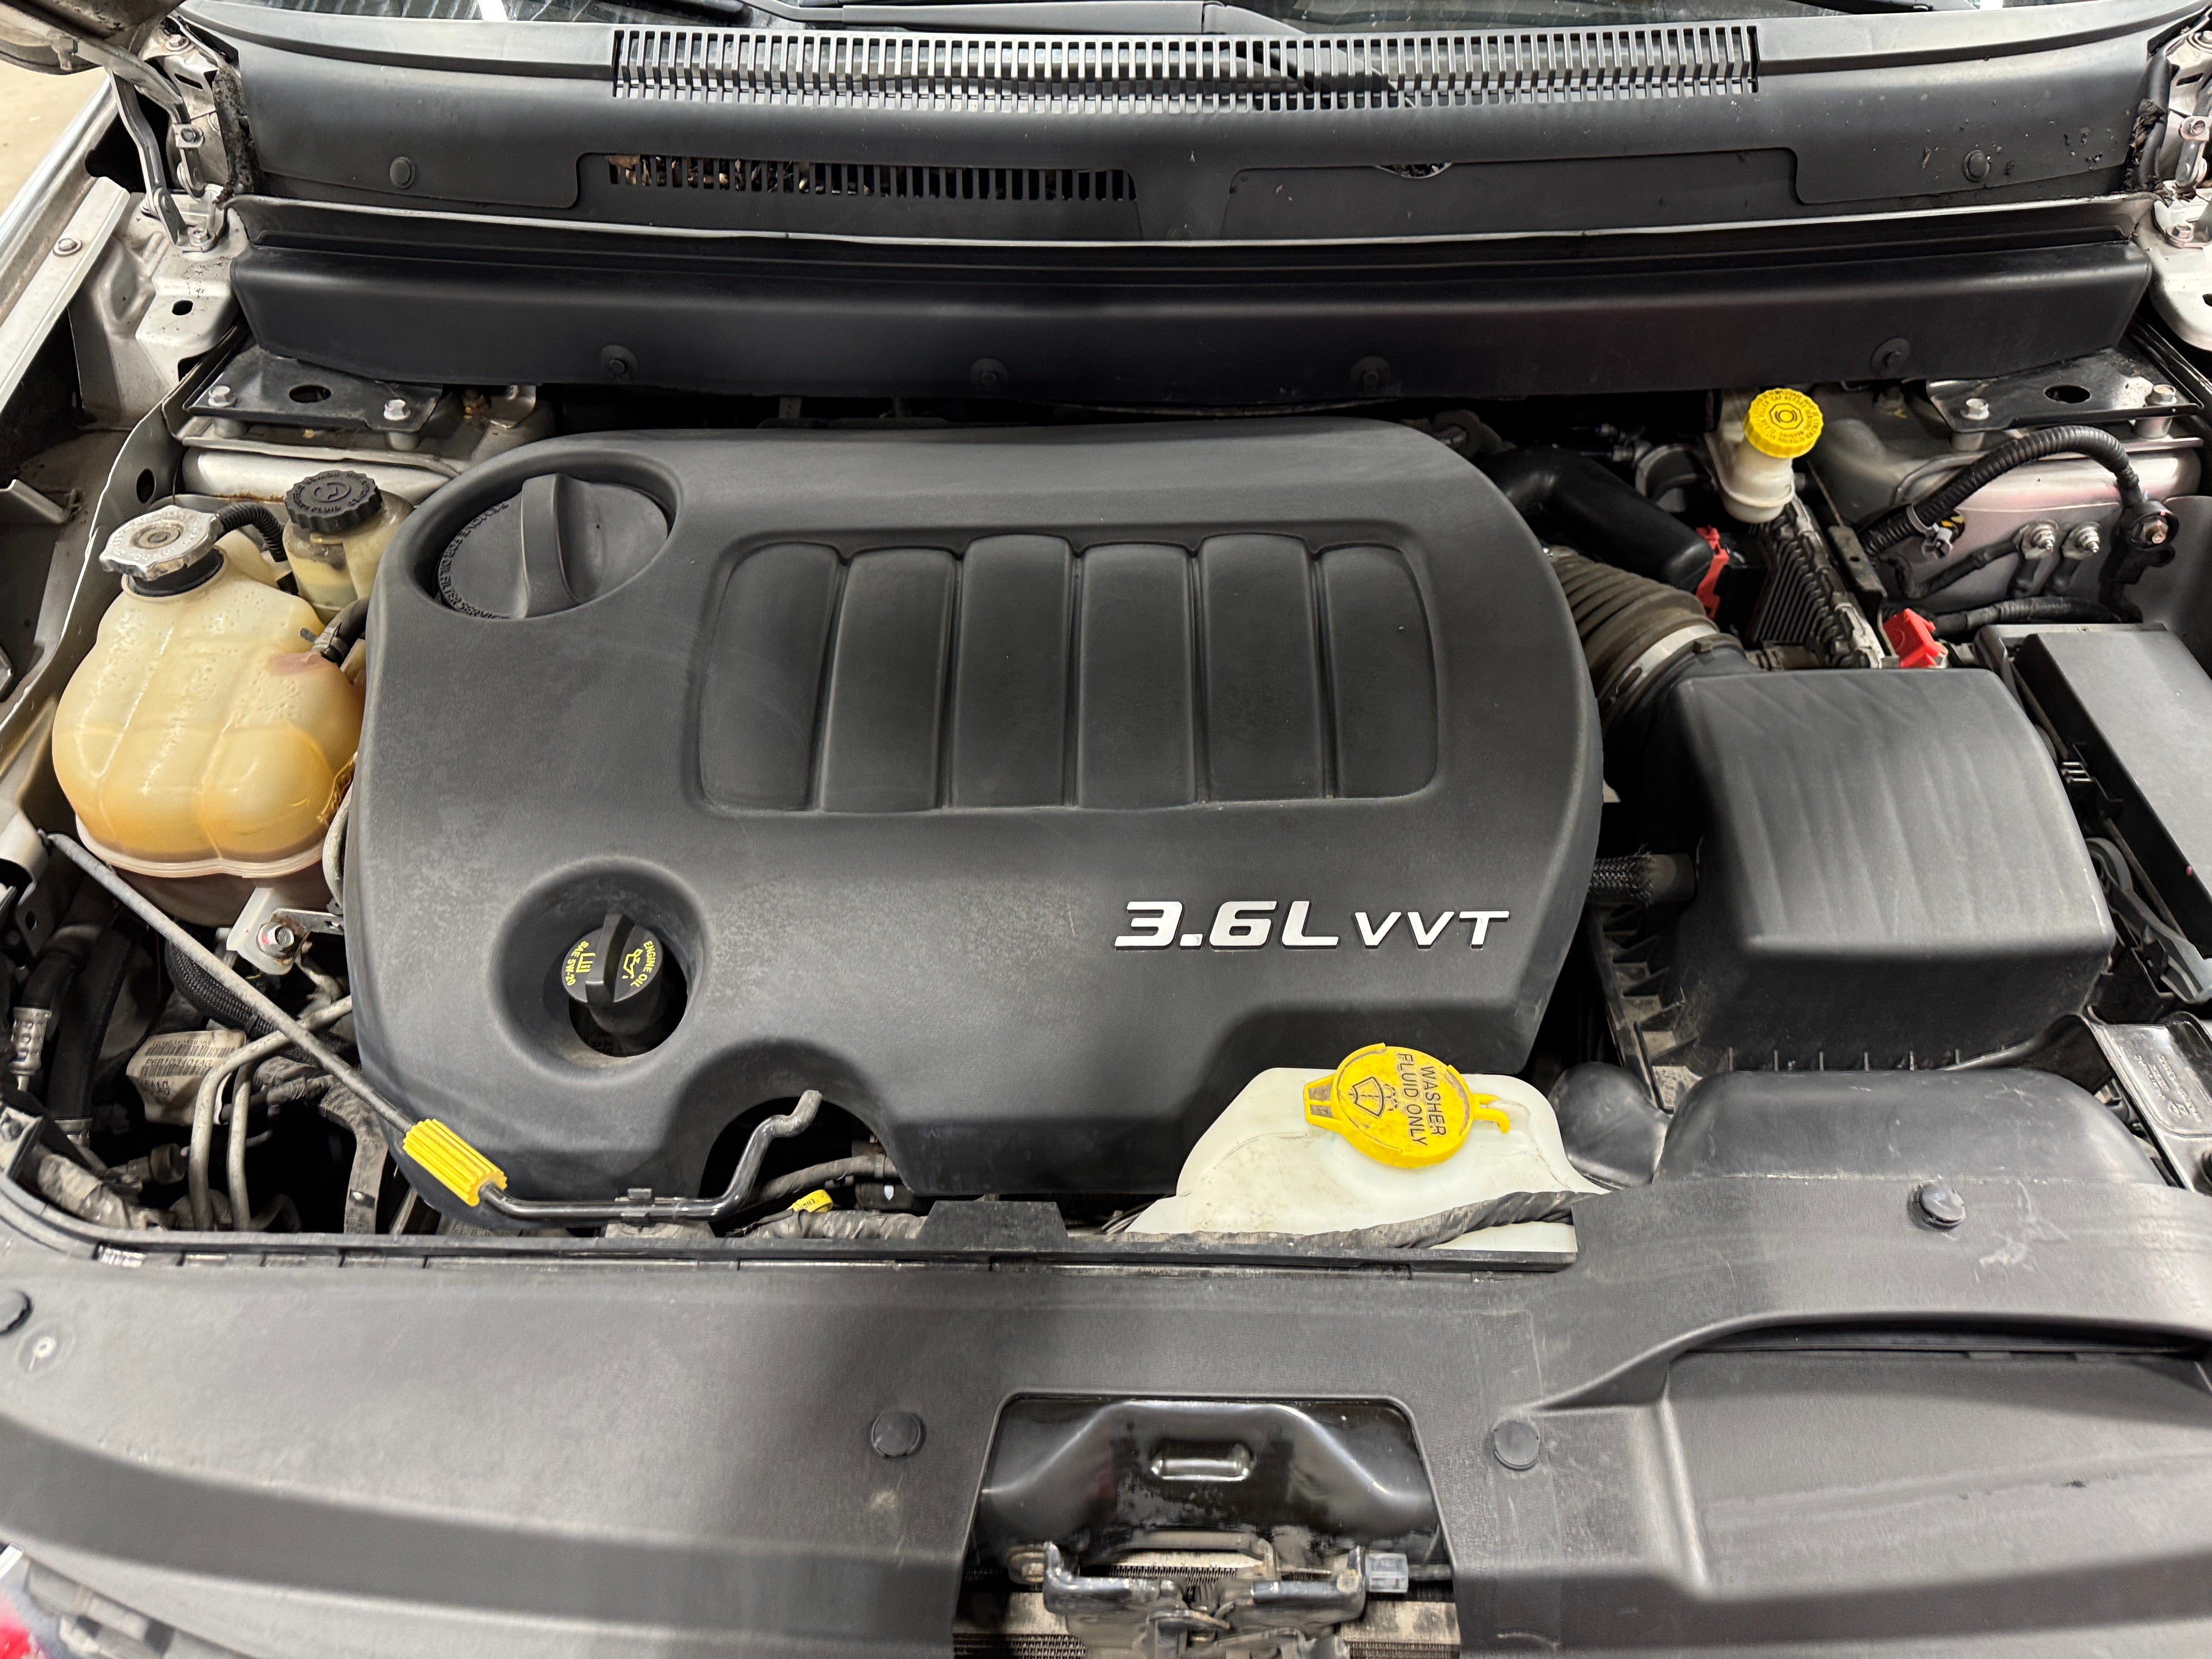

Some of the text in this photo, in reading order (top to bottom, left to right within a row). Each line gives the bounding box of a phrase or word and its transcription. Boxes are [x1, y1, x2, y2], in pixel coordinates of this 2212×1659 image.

[1114, 900, 1510, 950] 3.6L VVT
[565, 941, 589, 986] SAE 5W-20
[630, 940, 656, 987] ENGINE OIL
[1397, 1053, 1428, 1146] FLUID ONLY
[1420, 1066, 1447, 1137] WASHER
